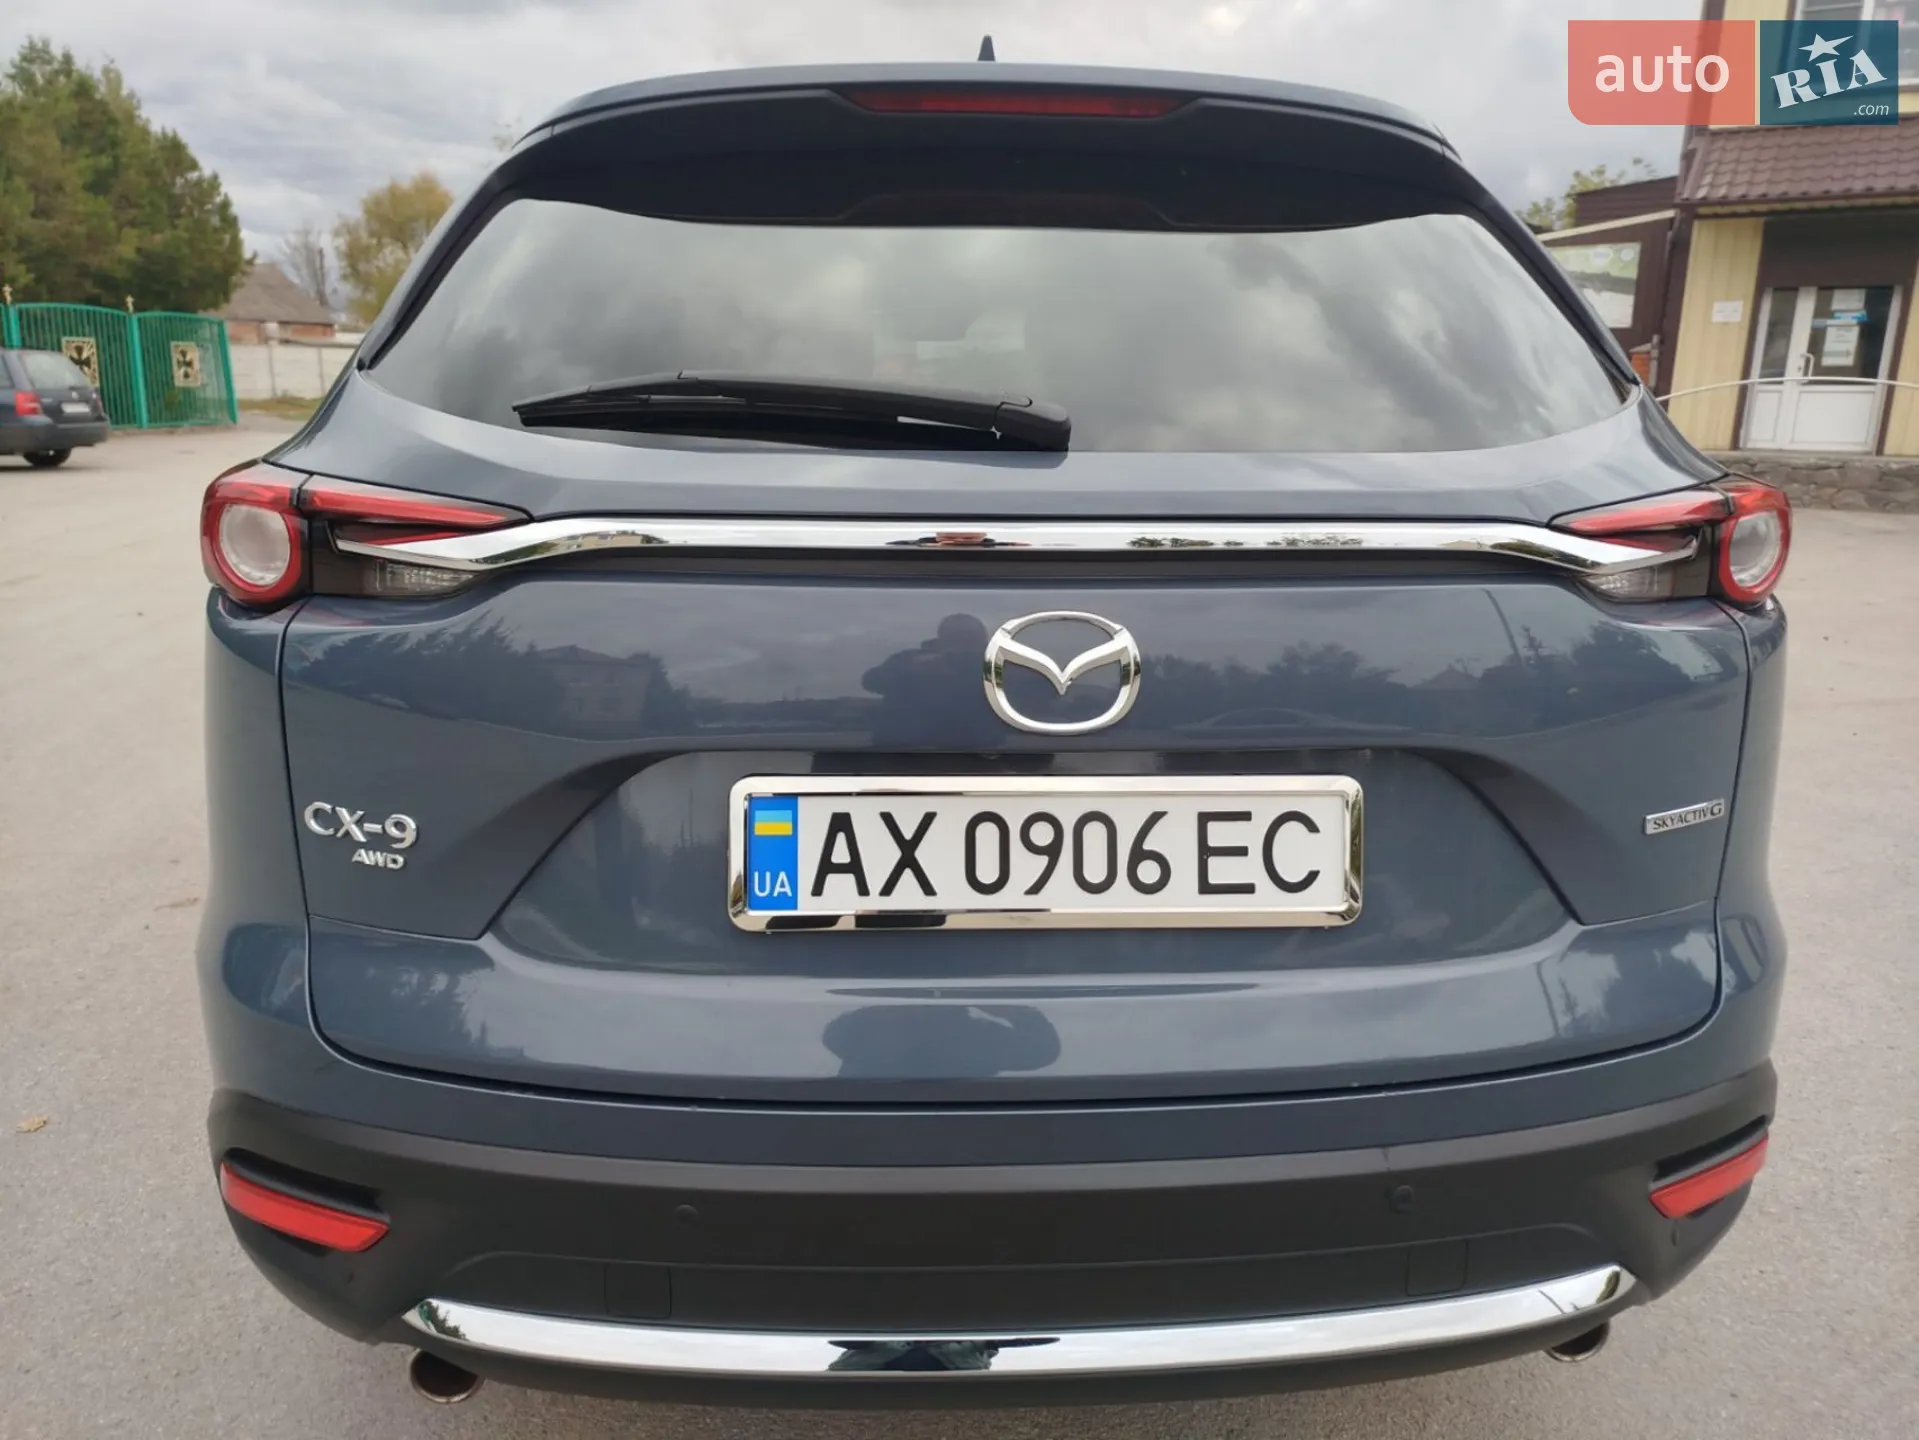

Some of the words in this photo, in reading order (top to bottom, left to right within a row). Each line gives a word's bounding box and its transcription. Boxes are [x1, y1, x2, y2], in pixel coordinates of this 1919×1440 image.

[304, 801, 418, 849] CX-9
[351, 848, 405, 870] AWD
[810, 810, 938, 898] AX
[963, 810, 1172, 897] 0906
[1197, 809, 1322, 896] EC
[753, 870, 793, 898] UA
